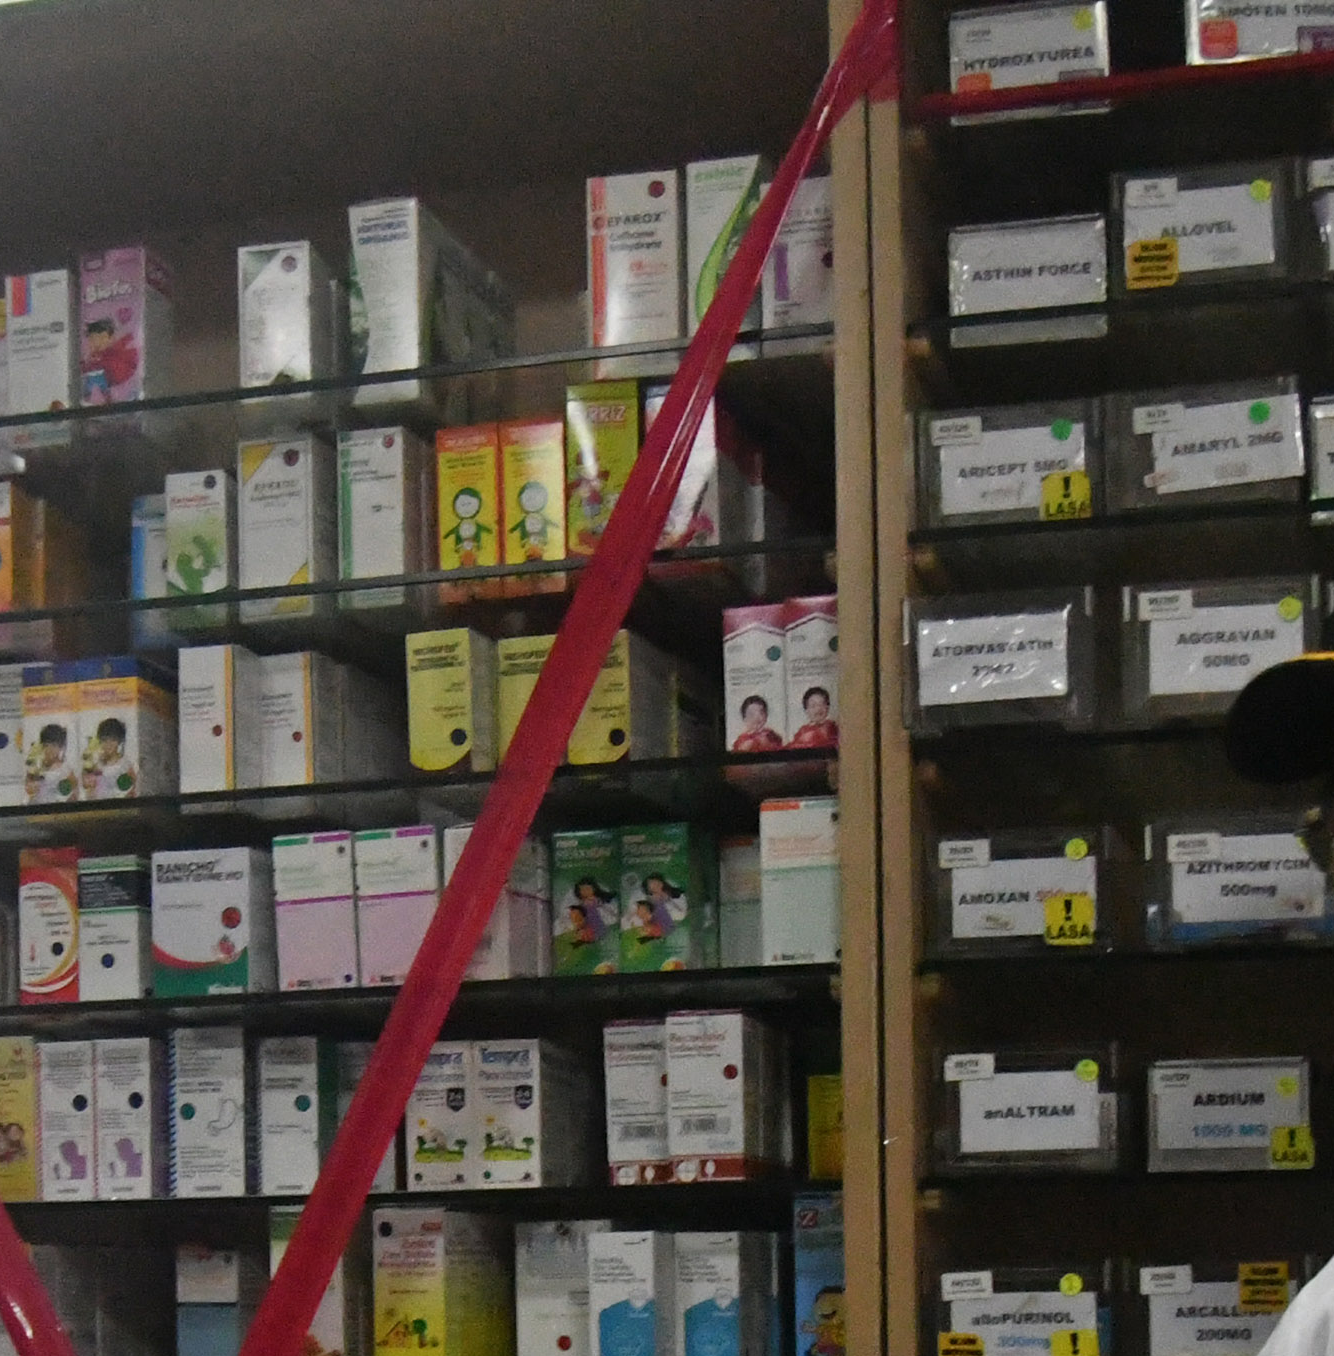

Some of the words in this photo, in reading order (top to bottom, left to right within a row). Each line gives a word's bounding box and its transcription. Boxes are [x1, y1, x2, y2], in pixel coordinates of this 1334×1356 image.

[1160, 219, 1237, 238] ALLOVEL
[1036, 261, 1093, 278] FORCE
[957, 461, 1027, 480] ARICEPT
[1175, 628, 1277, 647] AGGRAVAN
[1186, 859, 1312, 875] AZITHROMYCIN
[958, 889, 1031, 905] AMOXAN
[1193, 1092, 1265, 1108] ARDIUM
[983, 1103, 1076, 1120] anALTRAM
[1175, 1305, 1272, 1319] ARCALL
[1196, 1327, 1252, 1342] 200MG
